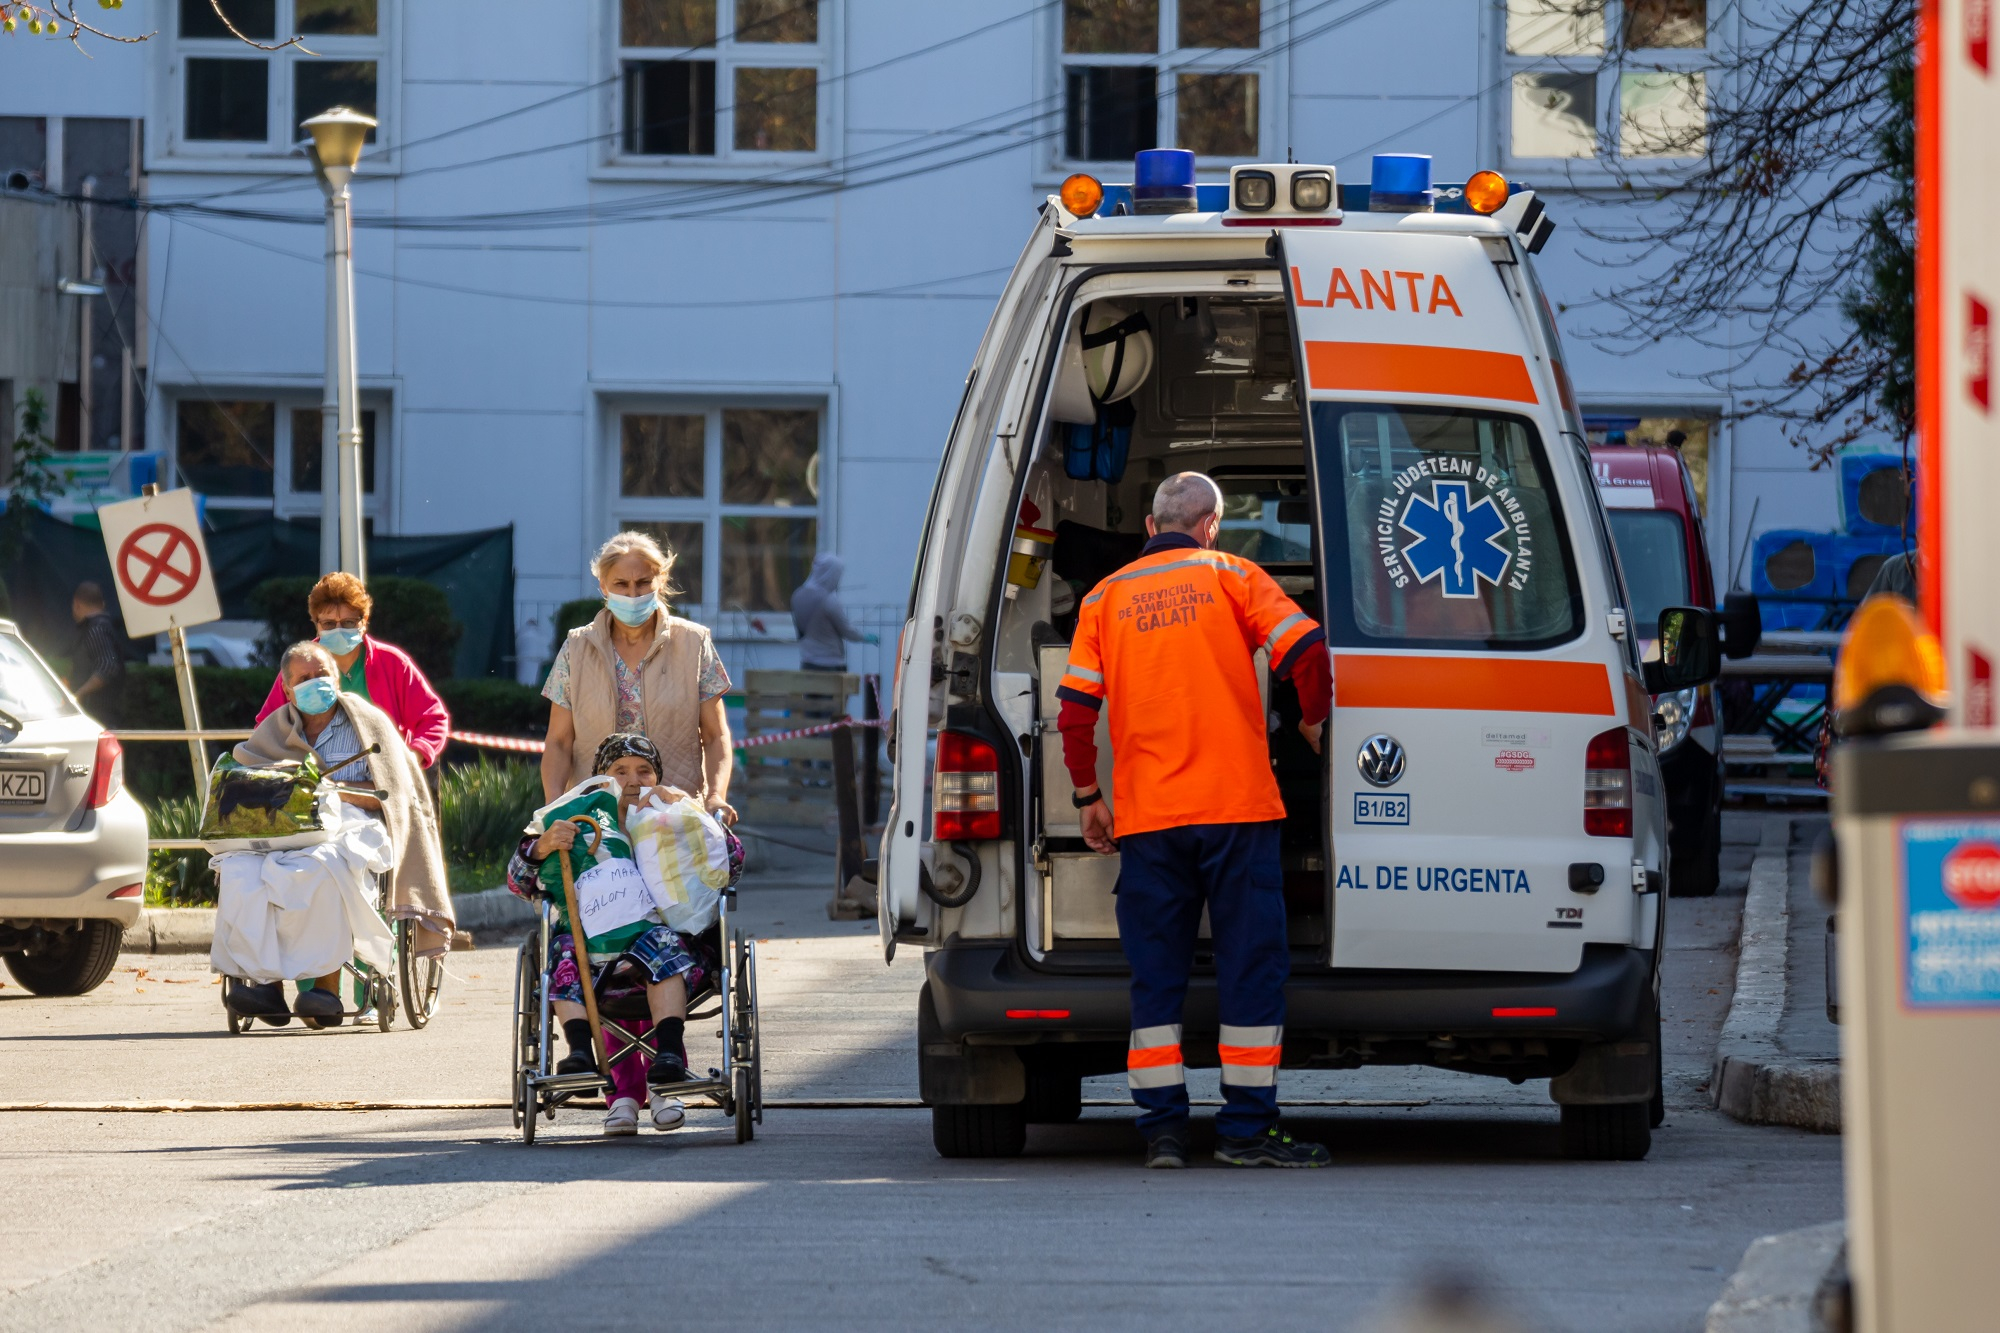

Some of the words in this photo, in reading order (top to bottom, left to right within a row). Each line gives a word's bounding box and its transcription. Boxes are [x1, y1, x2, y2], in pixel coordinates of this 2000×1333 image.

[1290, 266, 1463, 317] LANTA
[1392, 456, 1472, 495] JUDETEAN
[1475, 467, 1498, 489] DE
[1377, 497, 1410, 589] SERVICIUL
[1495, 487, 1532, 591] AMBULANTA
[1131, 583, 1197, 605] SERVICIUL
[1118, 606, 1133, 620] DE
[1, 774, 41, 797] KZD
[1358, 801, 1406, 817] B1/B2
[1335, 865, 1368, 889] AL
[1376, 866, 1408, 890] DE
[1416, 867, 1531, 893] URGENTA
[584, 888, 626, 917] SALON
[1555, 907, 1583, 919] TDI
